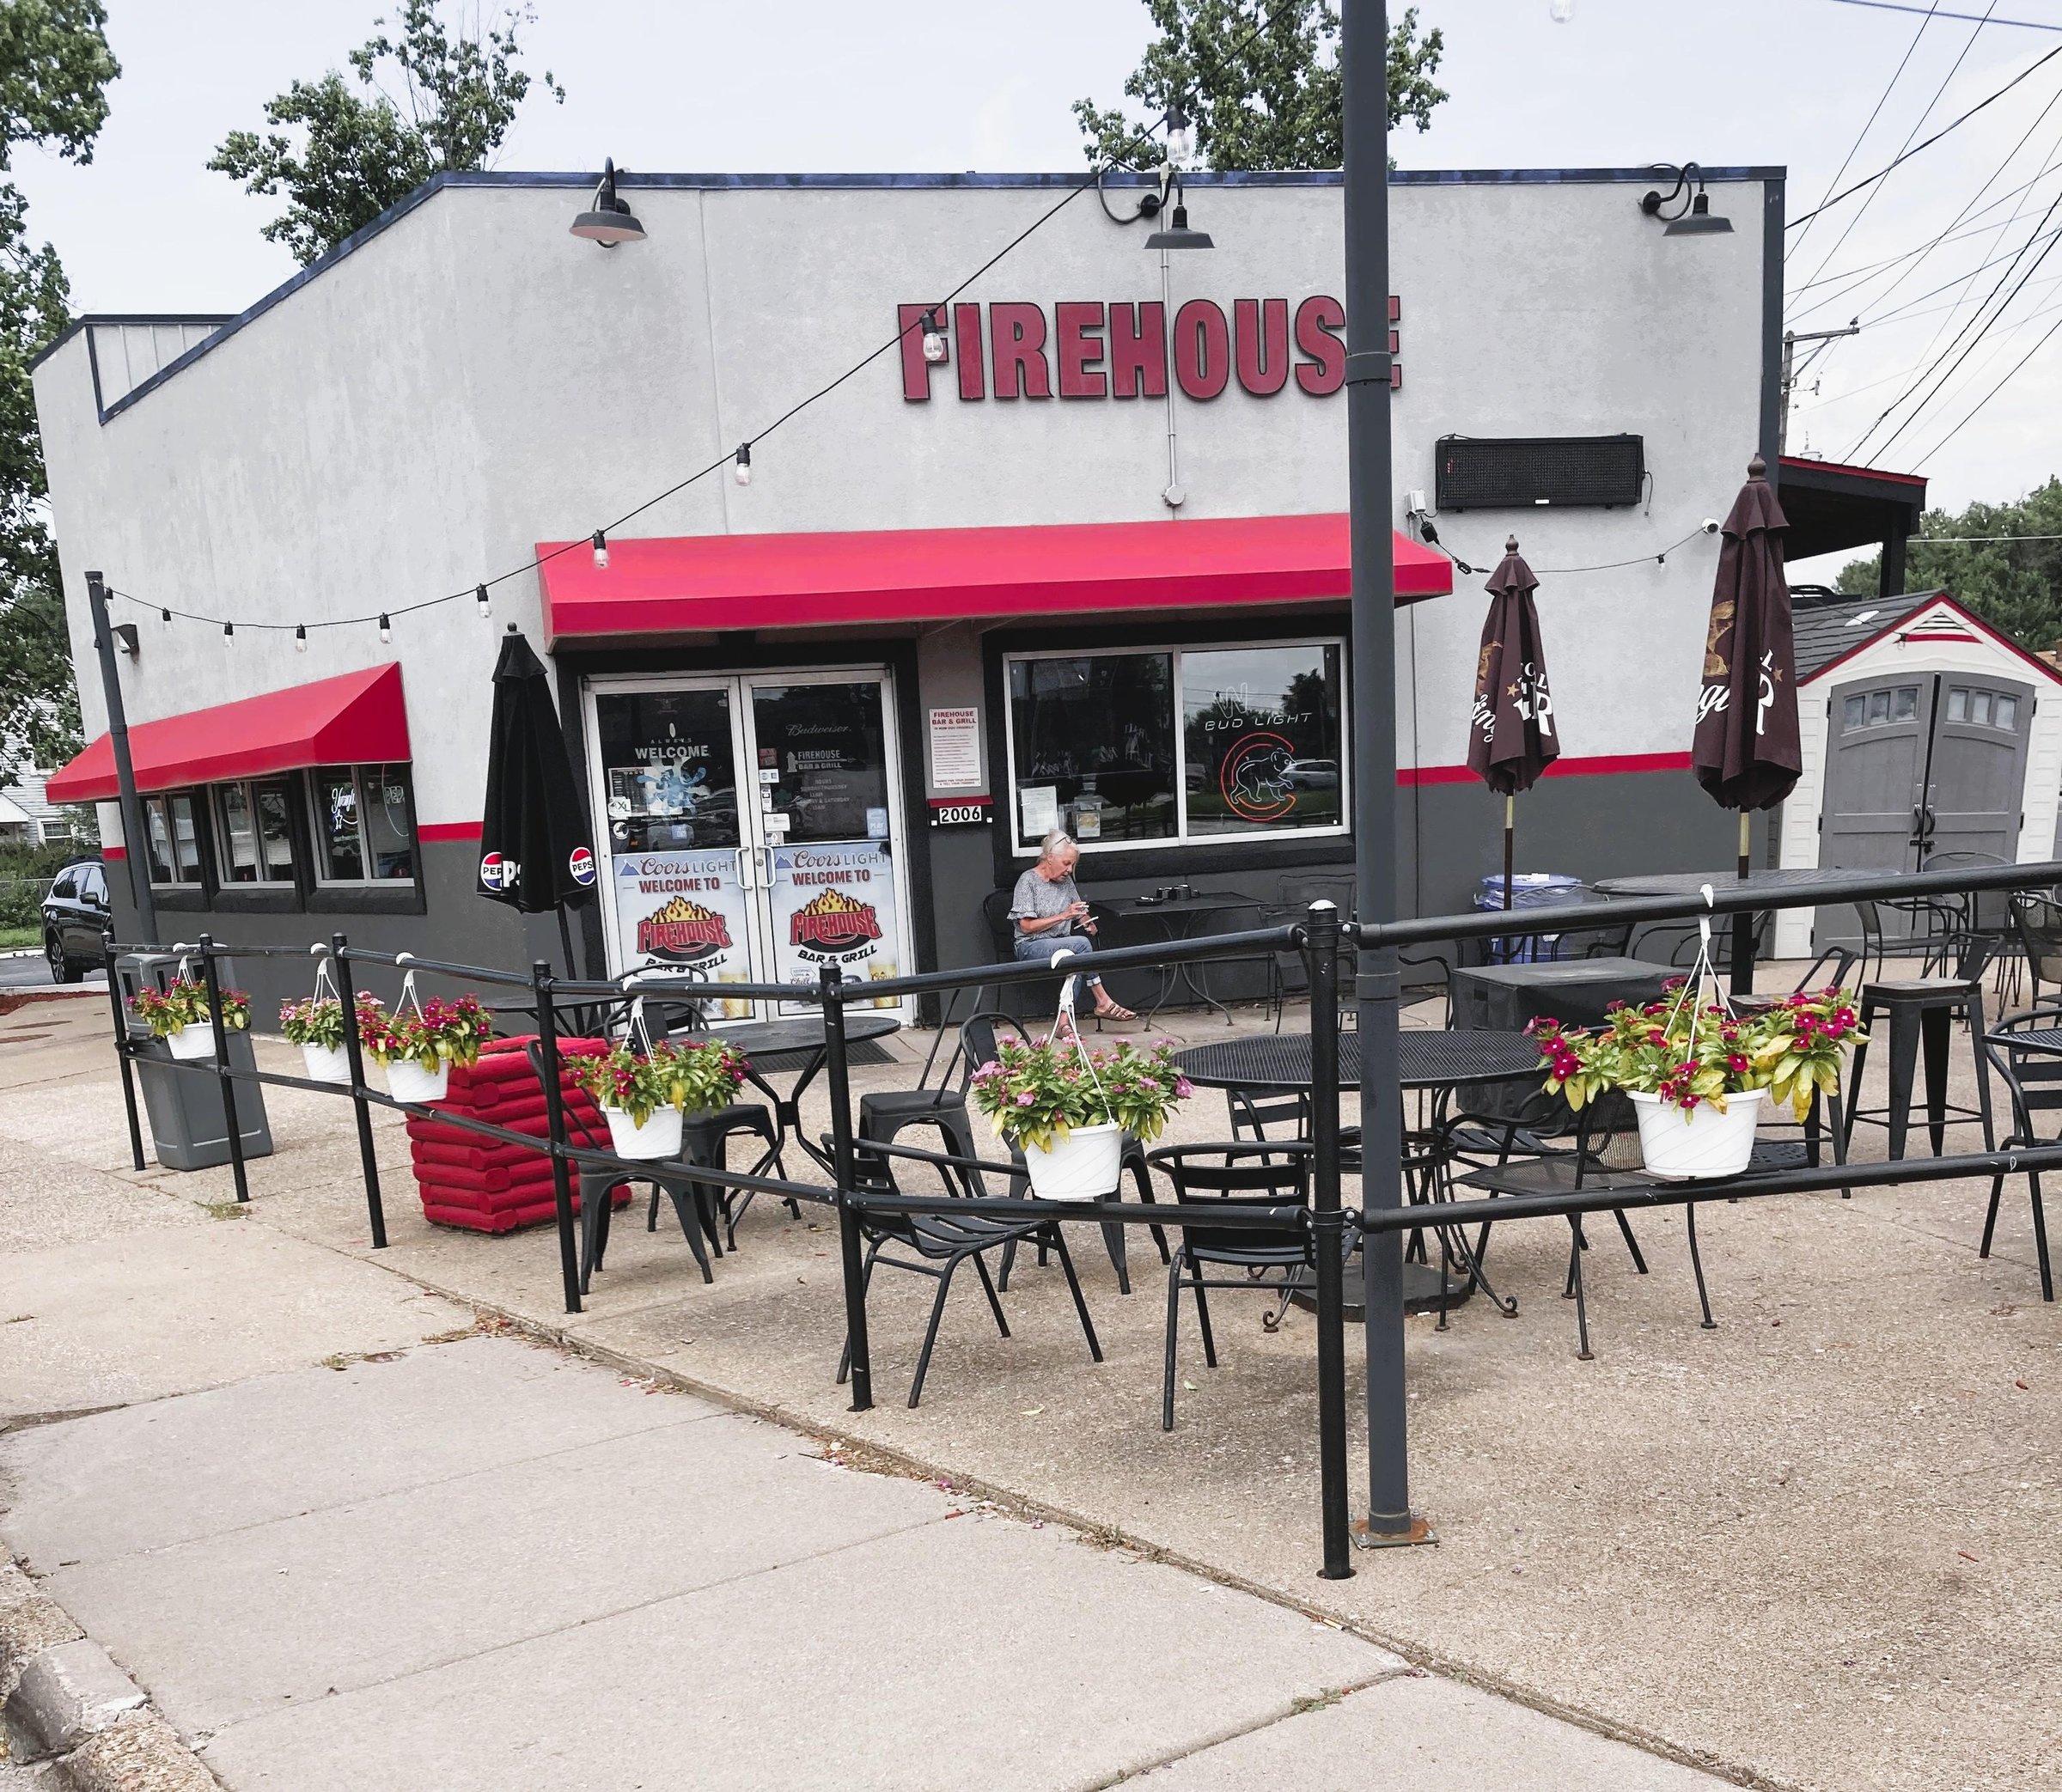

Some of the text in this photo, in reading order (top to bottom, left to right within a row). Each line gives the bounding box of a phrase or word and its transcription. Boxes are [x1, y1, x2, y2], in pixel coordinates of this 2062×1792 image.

[897, 295, 1402, 402] FIREHOUS
[785, 723, 849, 736] Budweiser
[1205, 712, 1313, 731] BUD LIGHT
[634, 745, 709, 759] WELCOME
[797, 749, 840, 760] FIREHOUSE
[940, 807, 981, 823] 2006
[571, 861, 593, 872] PEPS
[639, 857, 736, 876] Coors LIGHT
[793, 850, 887, 869] Coors LIGHT
[483, 867, 501, 875] PEP
[791, 869, 870, 886] WELCOME TO
[638, 877, 720, 893] WELCOME TO
[637, 914, 734, 954] FIREHOUSE
[790, 905, 883, 946] FIREHOUSE
[797, 949, 826, 964] BAR
[841, 944, 878, 964] GRILL
